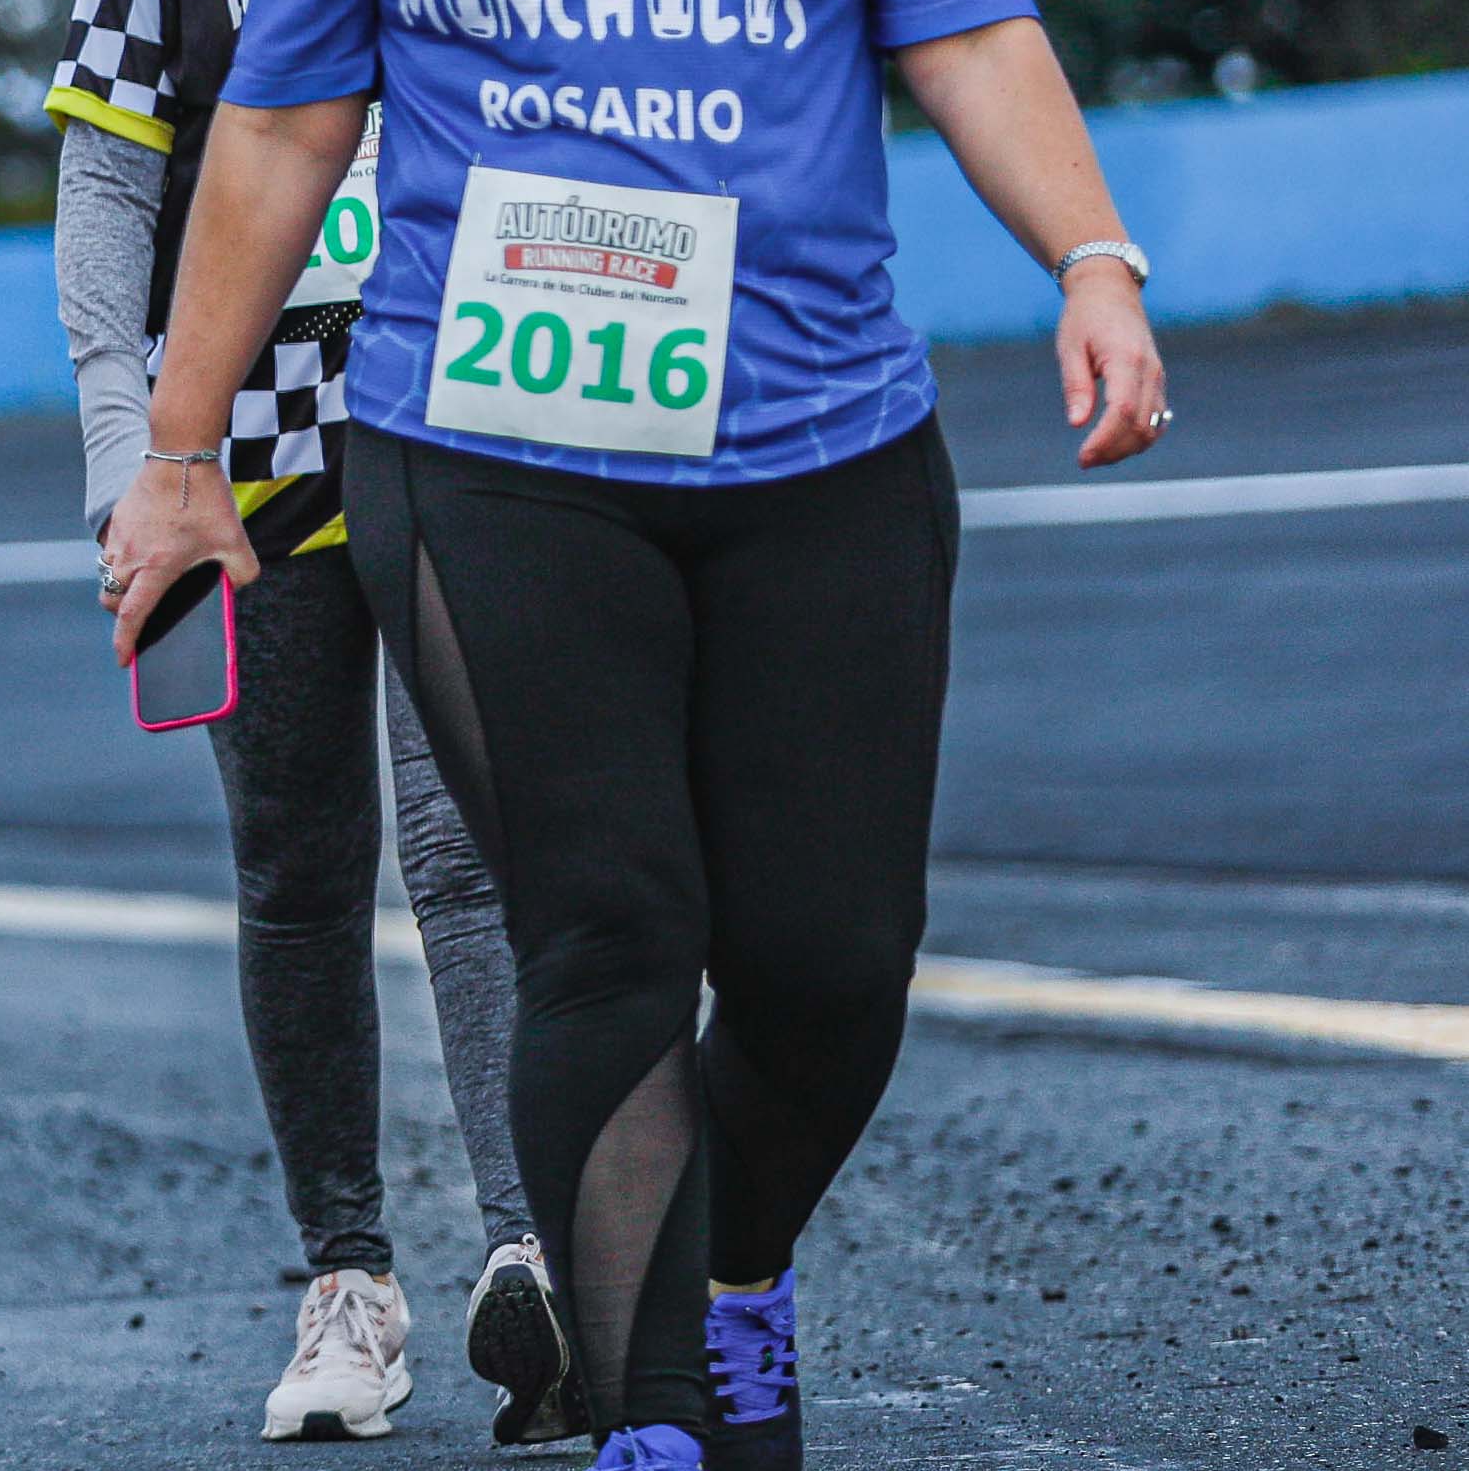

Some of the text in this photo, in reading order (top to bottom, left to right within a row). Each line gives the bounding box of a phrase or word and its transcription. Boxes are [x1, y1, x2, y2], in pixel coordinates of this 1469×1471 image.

[478, 79, 744, 144] ROSARIO
[495, 194, 697, 262] AUTÓDROMO
[521, 247, 659, 283] RUNNING RACE
[445, 301, 709, 411] 2016
